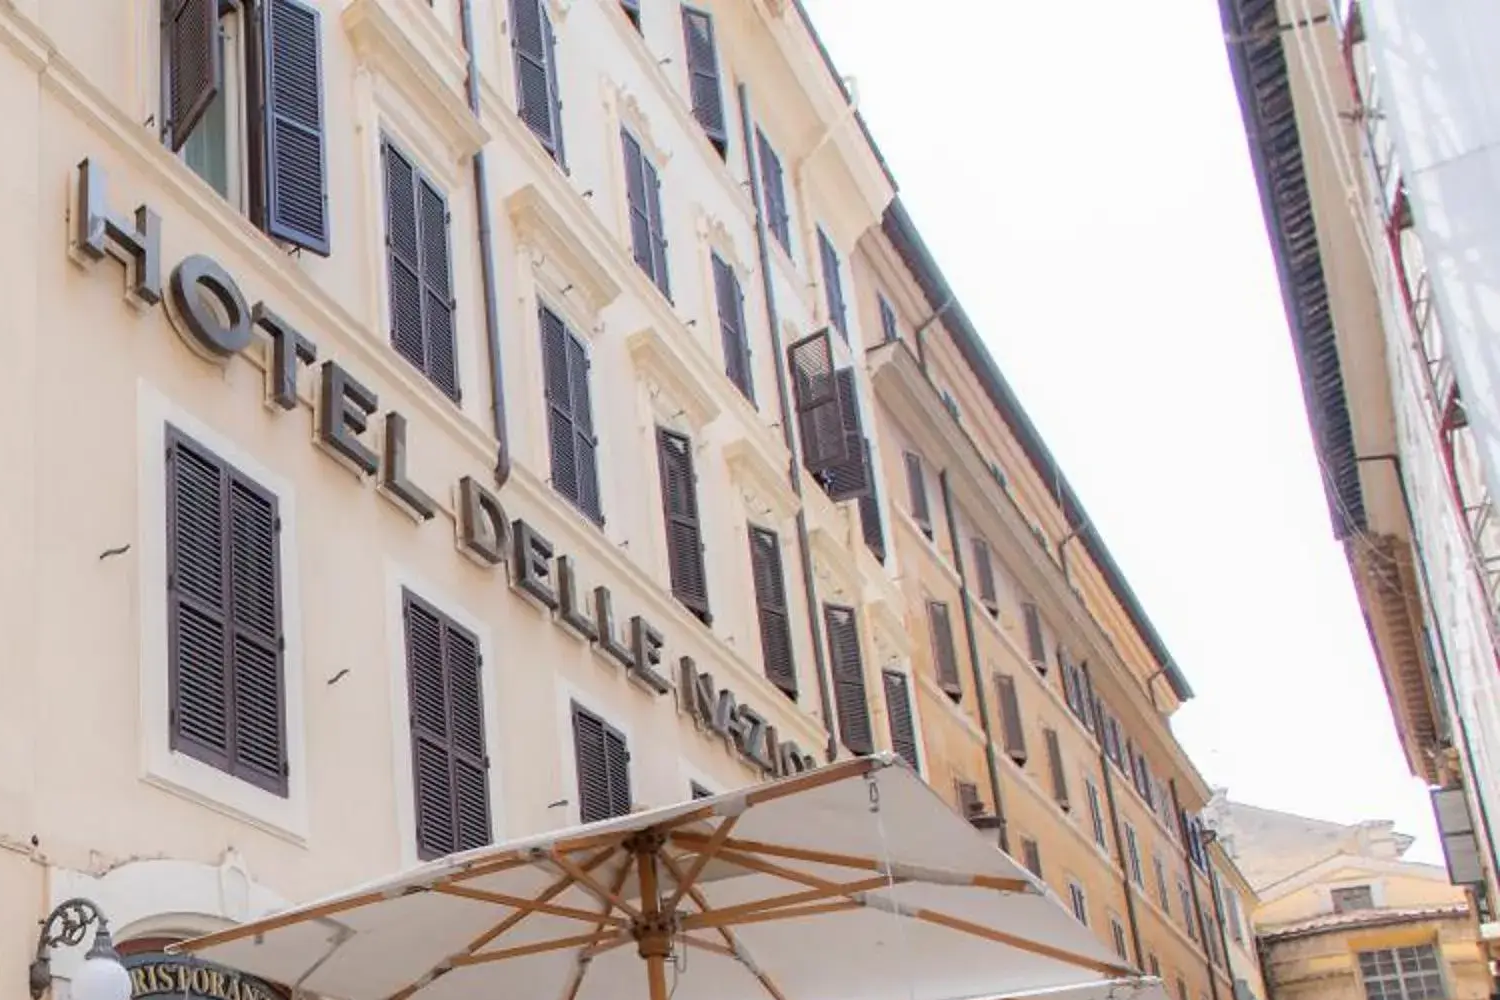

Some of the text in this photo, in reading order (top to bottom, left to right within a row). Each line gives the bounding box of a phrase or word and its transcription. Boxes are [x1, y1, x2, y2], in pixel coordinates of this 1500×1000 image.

[74, 156, 817, 779] HOTEL DELLE NAZIO
